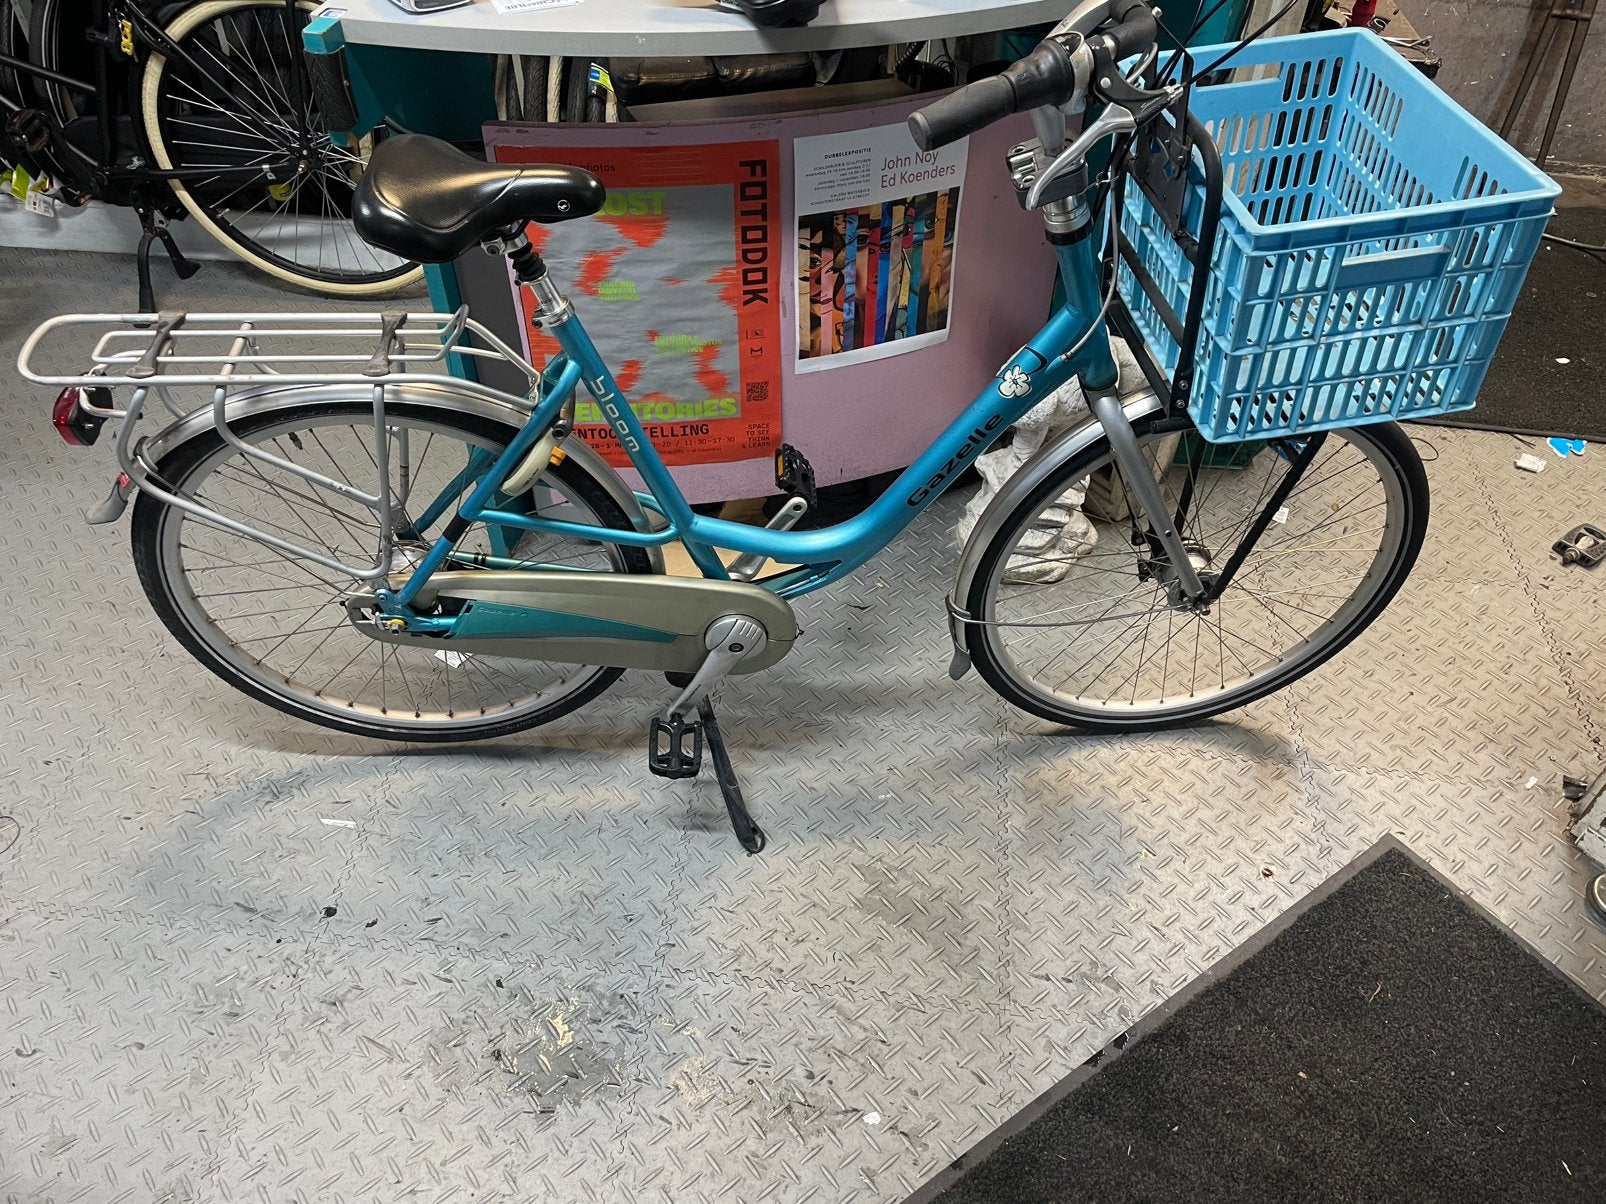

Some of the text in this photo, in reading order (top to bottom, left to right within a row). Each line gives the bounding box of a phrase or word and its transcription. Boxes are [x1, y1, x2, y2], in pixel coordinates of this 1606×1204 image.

[824, 147, 871, 160] DUBBELEXPOSITIE
[881, 154, 911, 171] John
[915, 150, 939, 165] Noy
[881, 173, 896, 188] Ed
[900, 165, 956, 185] Koenders
[596, 191, 666, 216] OST
[739, 159, 769, 307] FOTODOK
[590, 375, 640, 452] bloom
[748, 435, 770, 443] THINK
[749, 441, 770, 449] LEARN
[906, 413, 1004, 507] Gazelle
